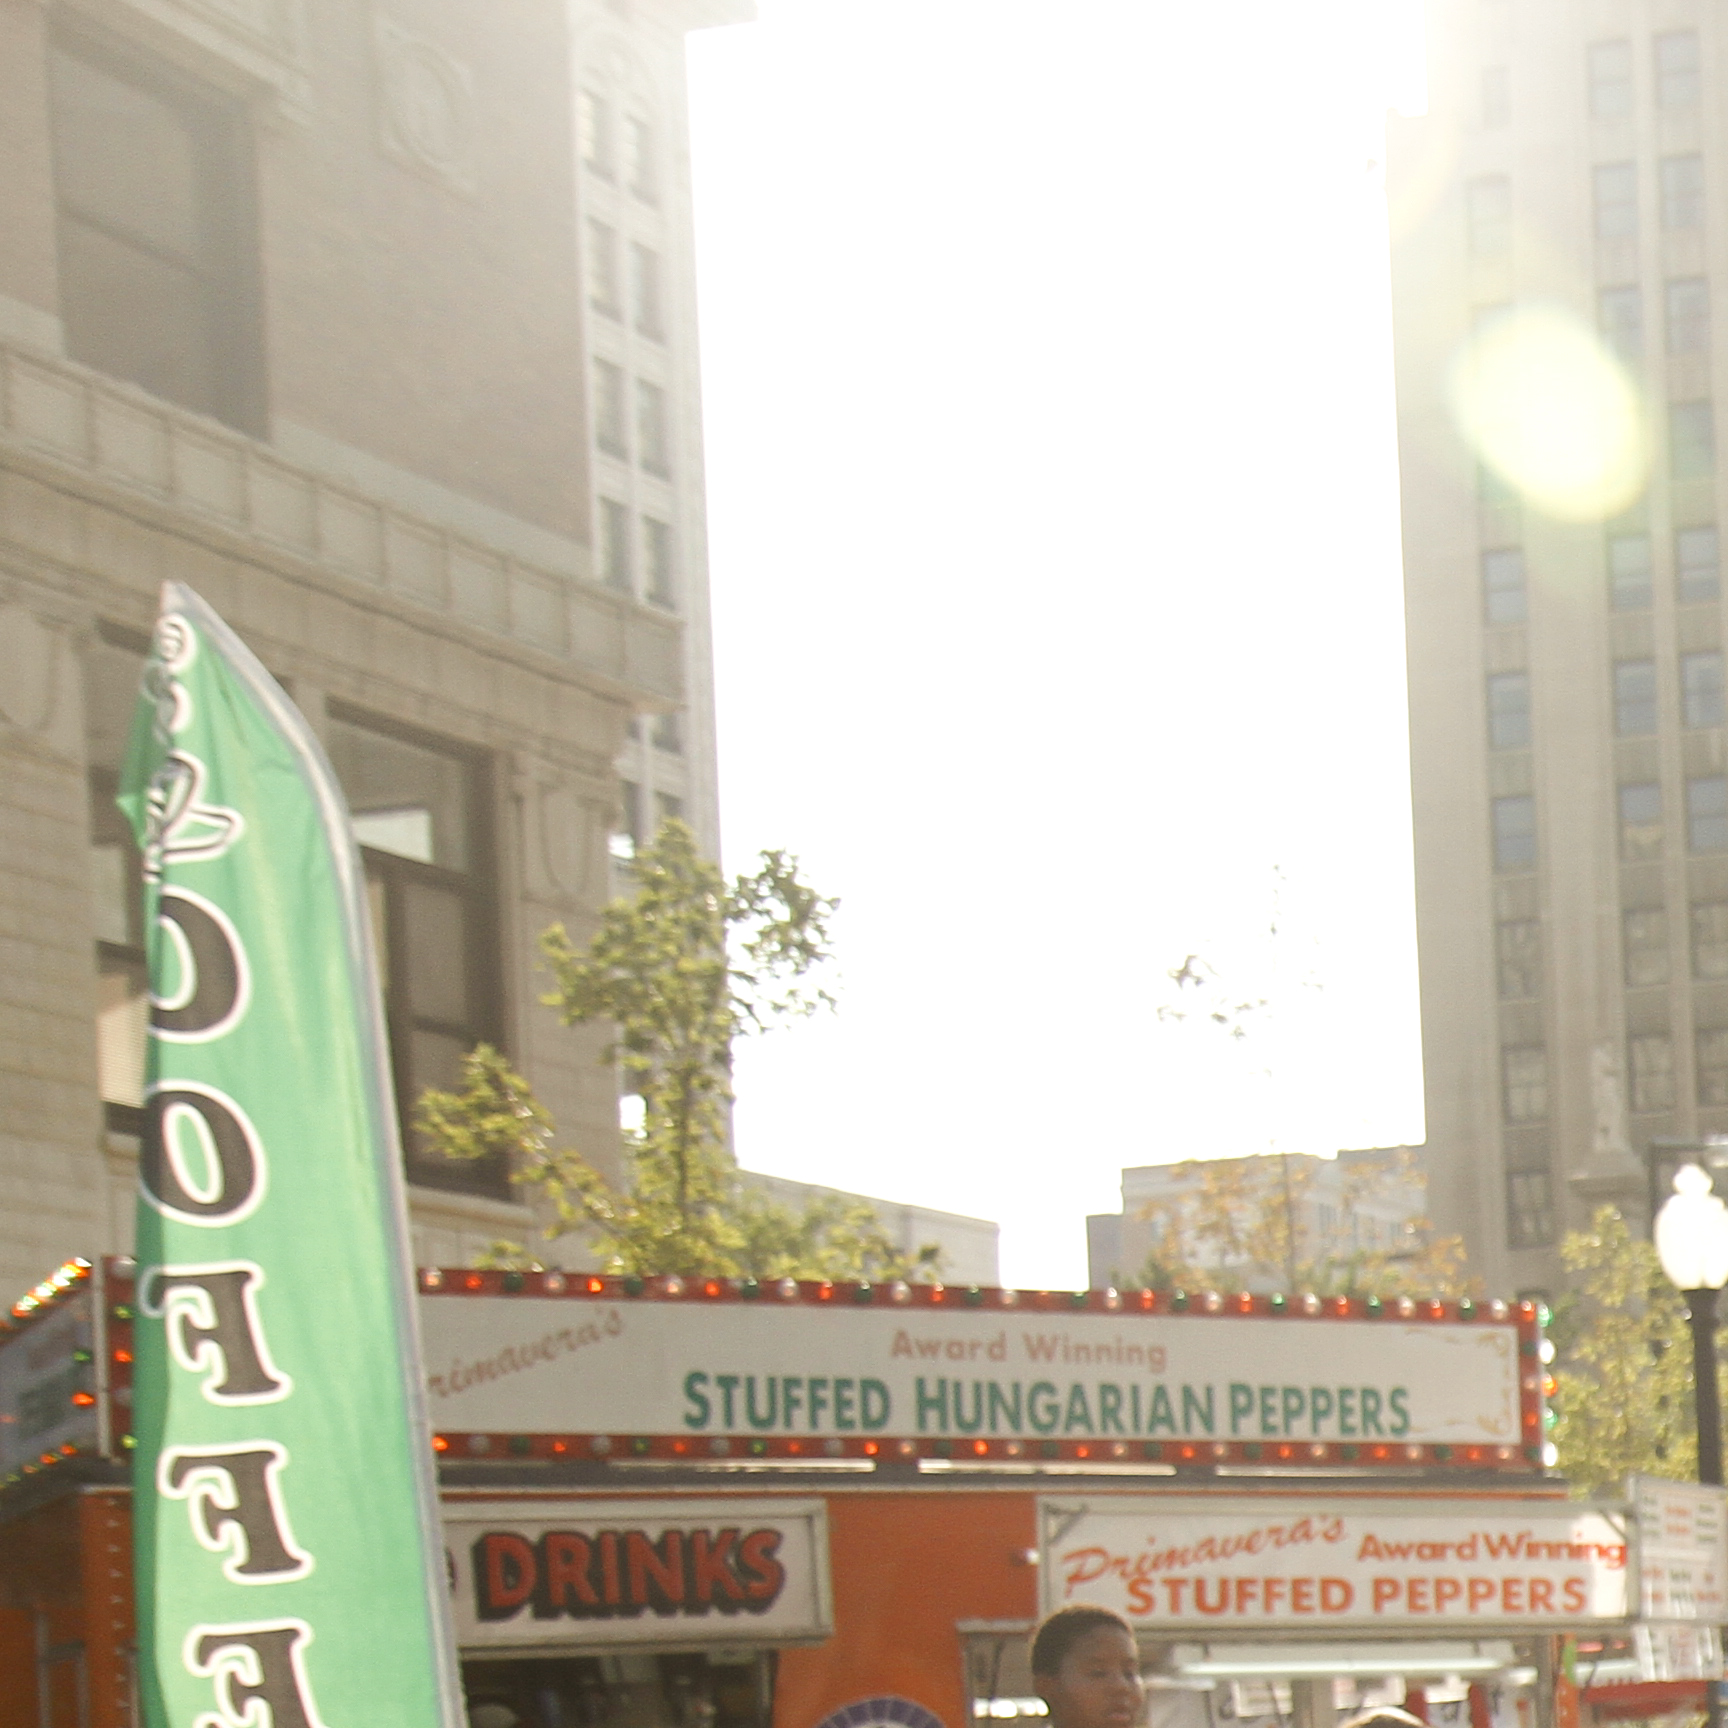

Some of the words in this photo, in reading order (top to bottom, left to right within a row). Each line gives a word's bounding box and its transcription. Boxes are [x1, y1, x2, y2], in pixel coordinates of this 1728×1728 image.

[428, 1306, 626, 1400] rimavera's
[892, 1330, 1008, 1364] Award
[1022, 1333, 1168, 1372] Winning
[683, 1371, 891, 1430] STUFFED
[914, 1377, 1216, 1436] HUNGARIAN
[1229, 1382, 1411, 1436] PEPPERS
[470, 1526, 786, 1624] DRINKS
[1061, 1514, 1347, 1596] Primavera's
[1357, 1534, 1485, 1563] Award
[1486, 1532, 1627, 1571] Winning
[1126, 1576, 1355, 1616] STUFFED
[1372, 1578, 1589, 1614] PEPPERS
